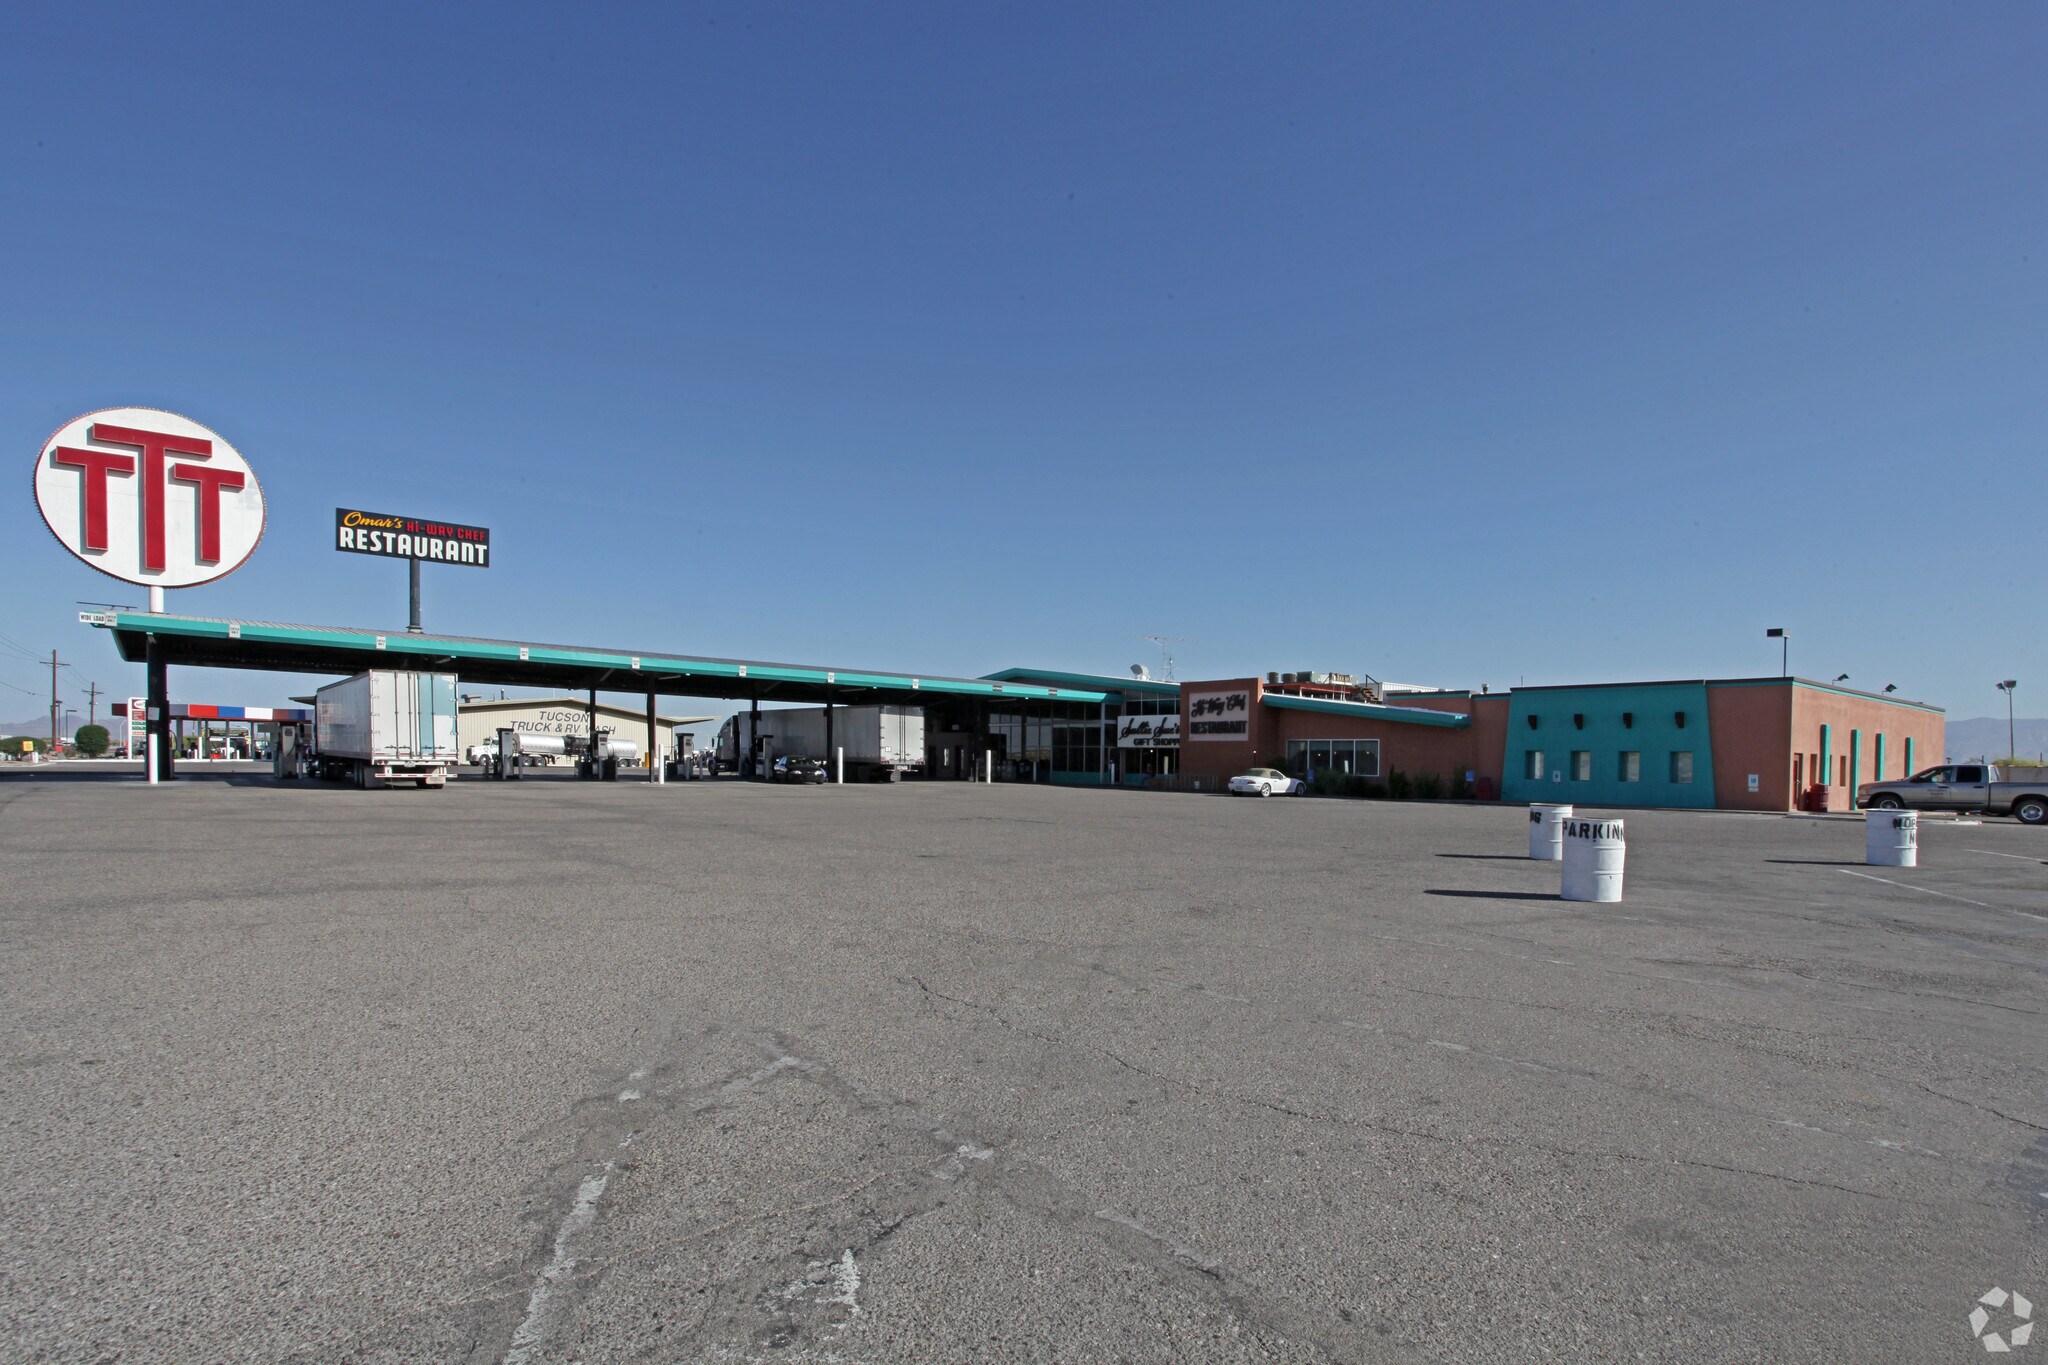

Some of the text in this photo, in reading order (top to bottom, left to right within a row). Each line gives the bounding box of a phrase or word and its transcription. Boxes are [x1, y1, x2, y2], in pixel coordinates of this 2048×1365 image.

[55, 423, 245, 571] TTT
[343, 511, 403, 528] Omar's
[457, 528, 485, 541] CHEF
[339, 527, 487, 564] RESTAURANT
[510, 720, 551, 732] TRUCK
[555, 724, 562, 732] &
[565, 724, 580, 734] RV
[539, 711, 590, 723] TUCSON
[1190, 721, 1247, 734] RESTAURANT
